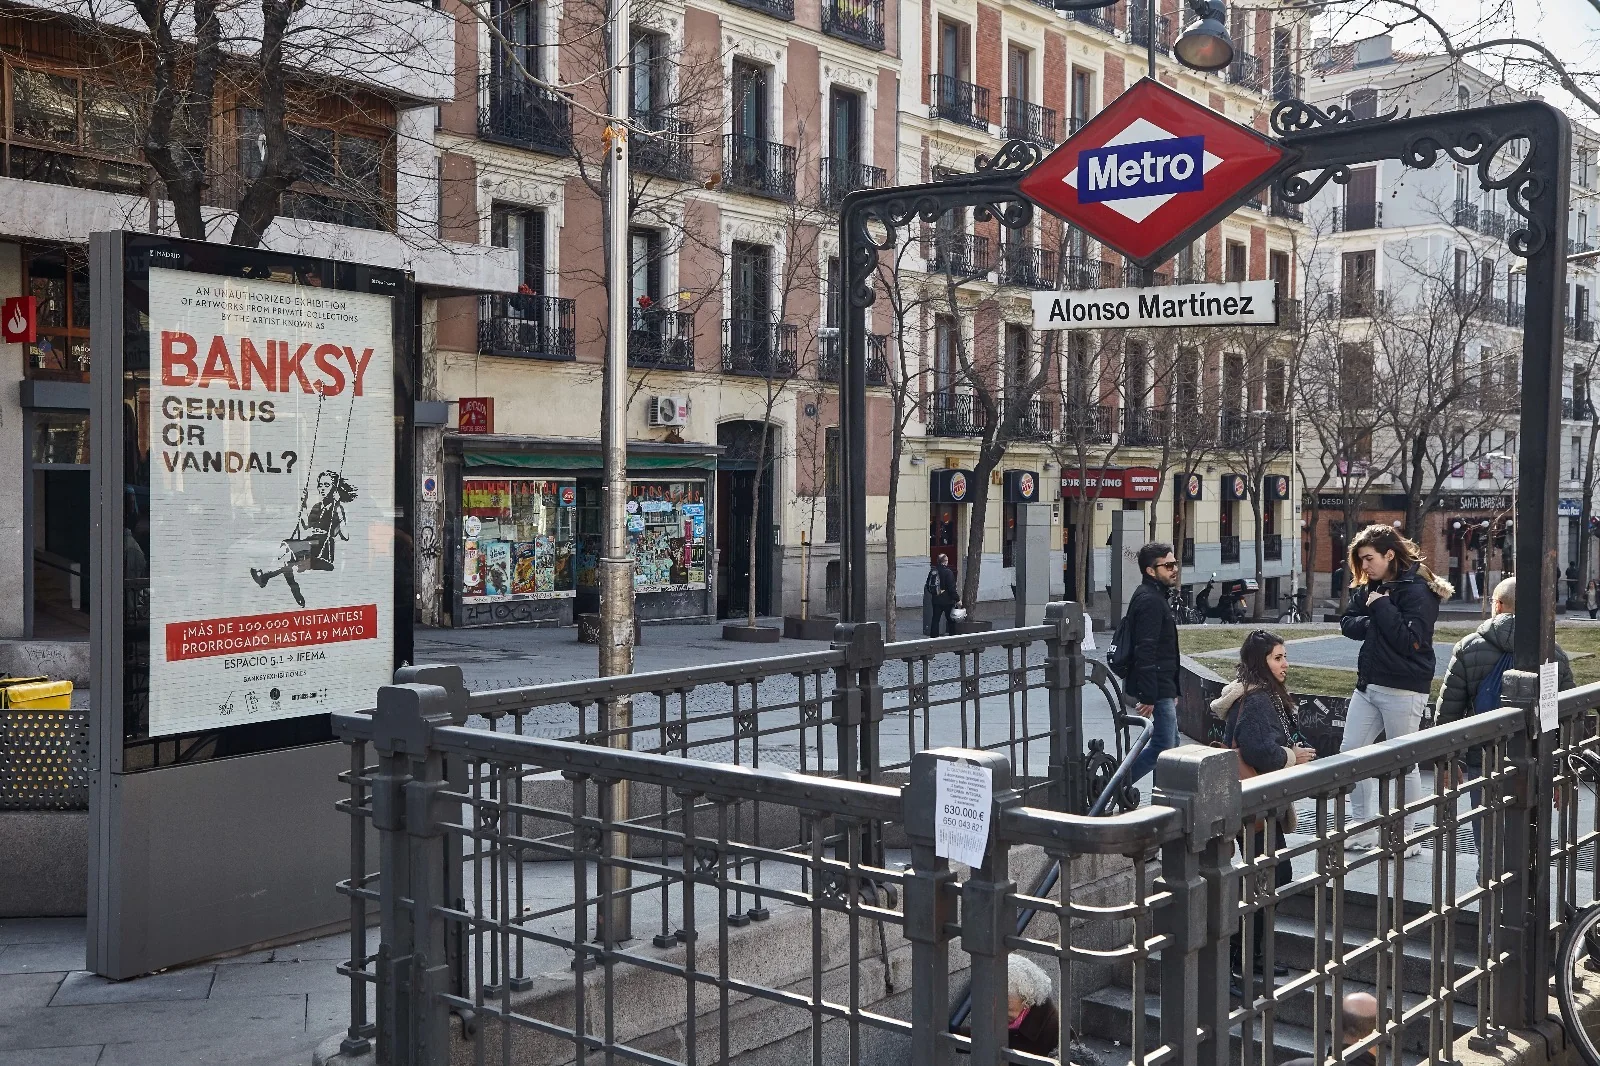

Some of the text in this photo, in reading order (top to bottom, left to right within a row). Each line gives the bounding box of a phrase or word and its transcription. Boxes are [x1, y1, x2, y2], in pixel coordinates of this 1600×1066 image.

[1088, 150, 1195, 191] Metro
[157, 251, 181, 259] MADRID
[181, 297, 359, 323] OF ARTWORKS FROM PRIVATE COLLECTIONS
[195, 286, 346, 310] AN UNAUTHORIZED EXHIBITION
[1049, 291, 1254, 322] Alonso Martínez
[221, 312, 325, 330] BY THE ARTIST KNOWN AS
[161, 331, 375, 397] BANKSY
[162, 395, 276, 423] GENIUS
[162, 423, 205, 447] OR
[162, 450, 298, 474] VANDAL?
[1061, 478, 1097, 487] BURER
[1460, 496, 1479, 509] SANTA
[183, 611, 364, 641] ¡MÁS DE 100.000 VISITANTES!
[182, 625, 364, 655] PRORROGADO HASTA 19 MAYO
[224, 650, 326, 670] ESPACIO 5.1 IFEMA
[943, 816, 957, 827] 650
